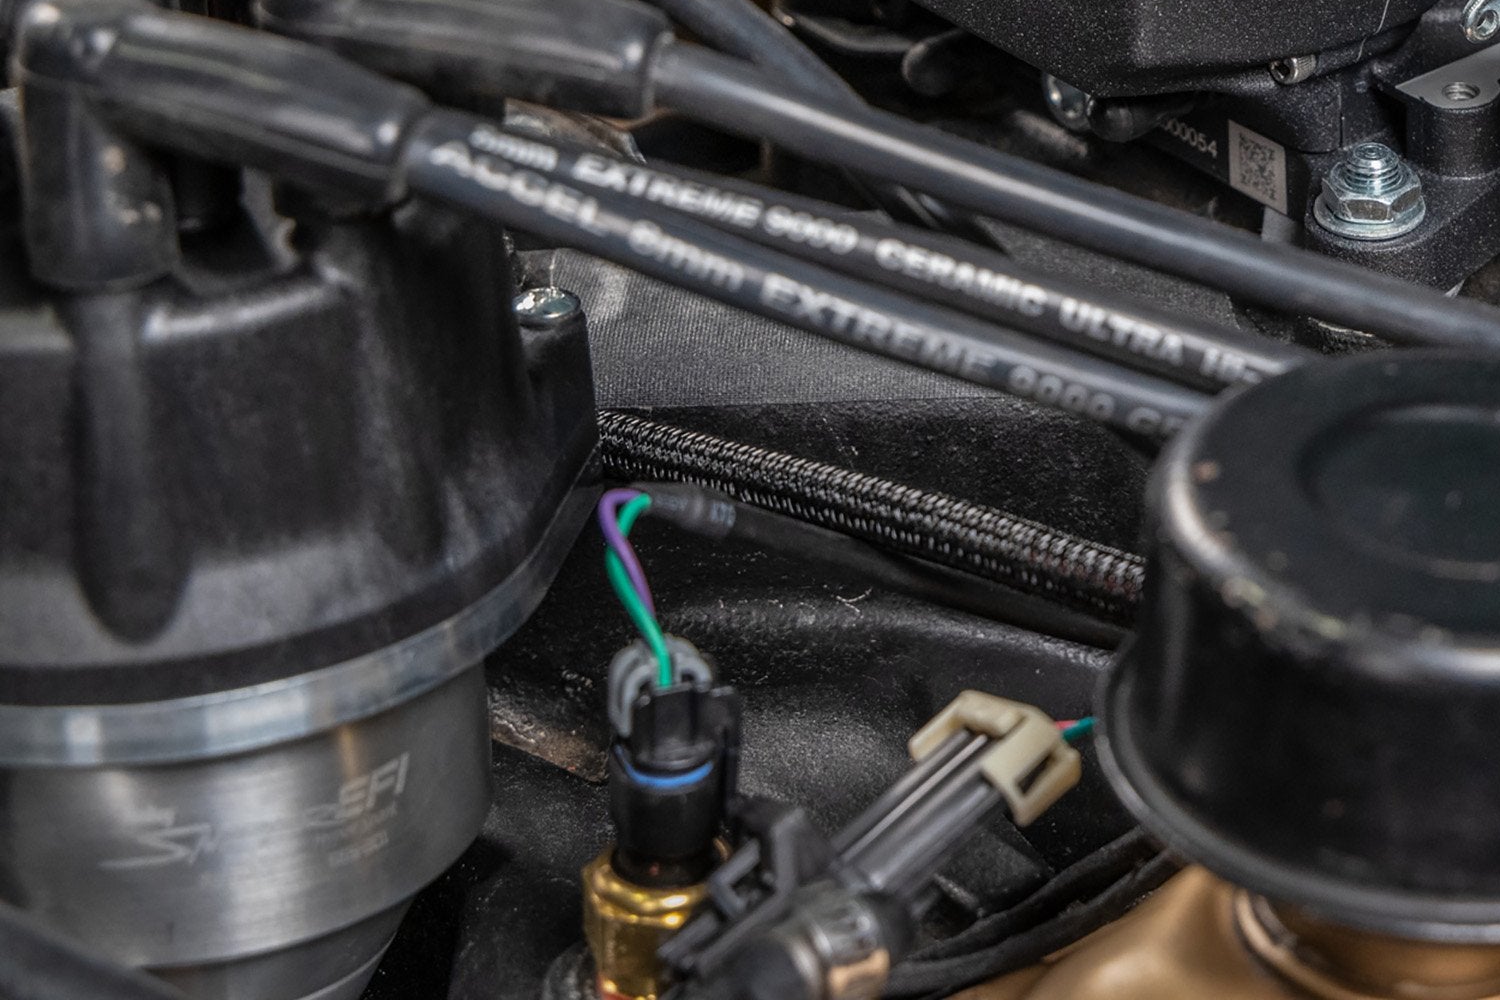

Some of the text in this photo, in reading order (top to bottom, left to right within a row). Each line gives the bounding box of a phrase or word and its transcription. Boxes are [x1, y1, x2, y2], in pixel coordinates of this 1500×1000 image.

[428, 141, 604, 236] ACCEL
[760, 271, 1000, 379] EXTREME
[570, 152, 765, 230] EXTREME
[1058, 296, 1186, 367] ULTRA
